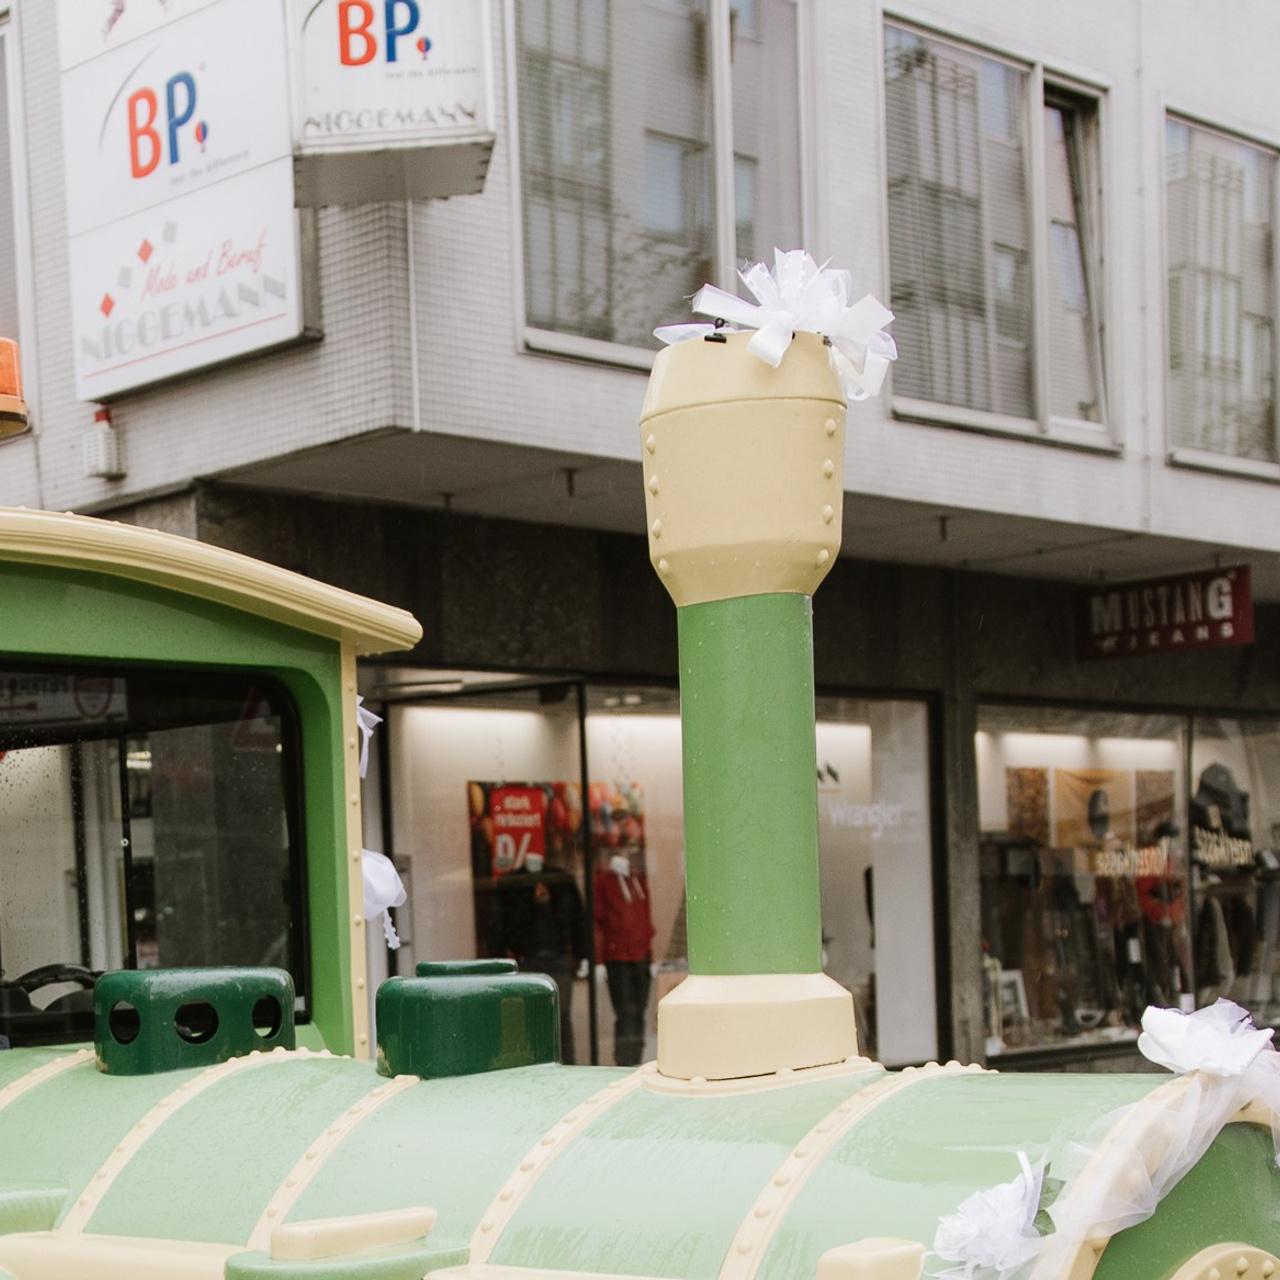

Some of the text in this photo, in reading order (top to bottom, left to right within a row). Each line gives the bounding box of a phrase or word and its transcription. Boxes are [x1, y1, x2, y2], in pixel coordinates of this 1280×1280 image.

[141, 228, 267, 304] Mode und Beruf
[80, 266, 288, 364] NIGGEMANN
[1091, 576, 1235, 634] MUSTANG
[1128, 621, 1236, 649] JEANS
[829, 800, 902, 839] Wrangler
